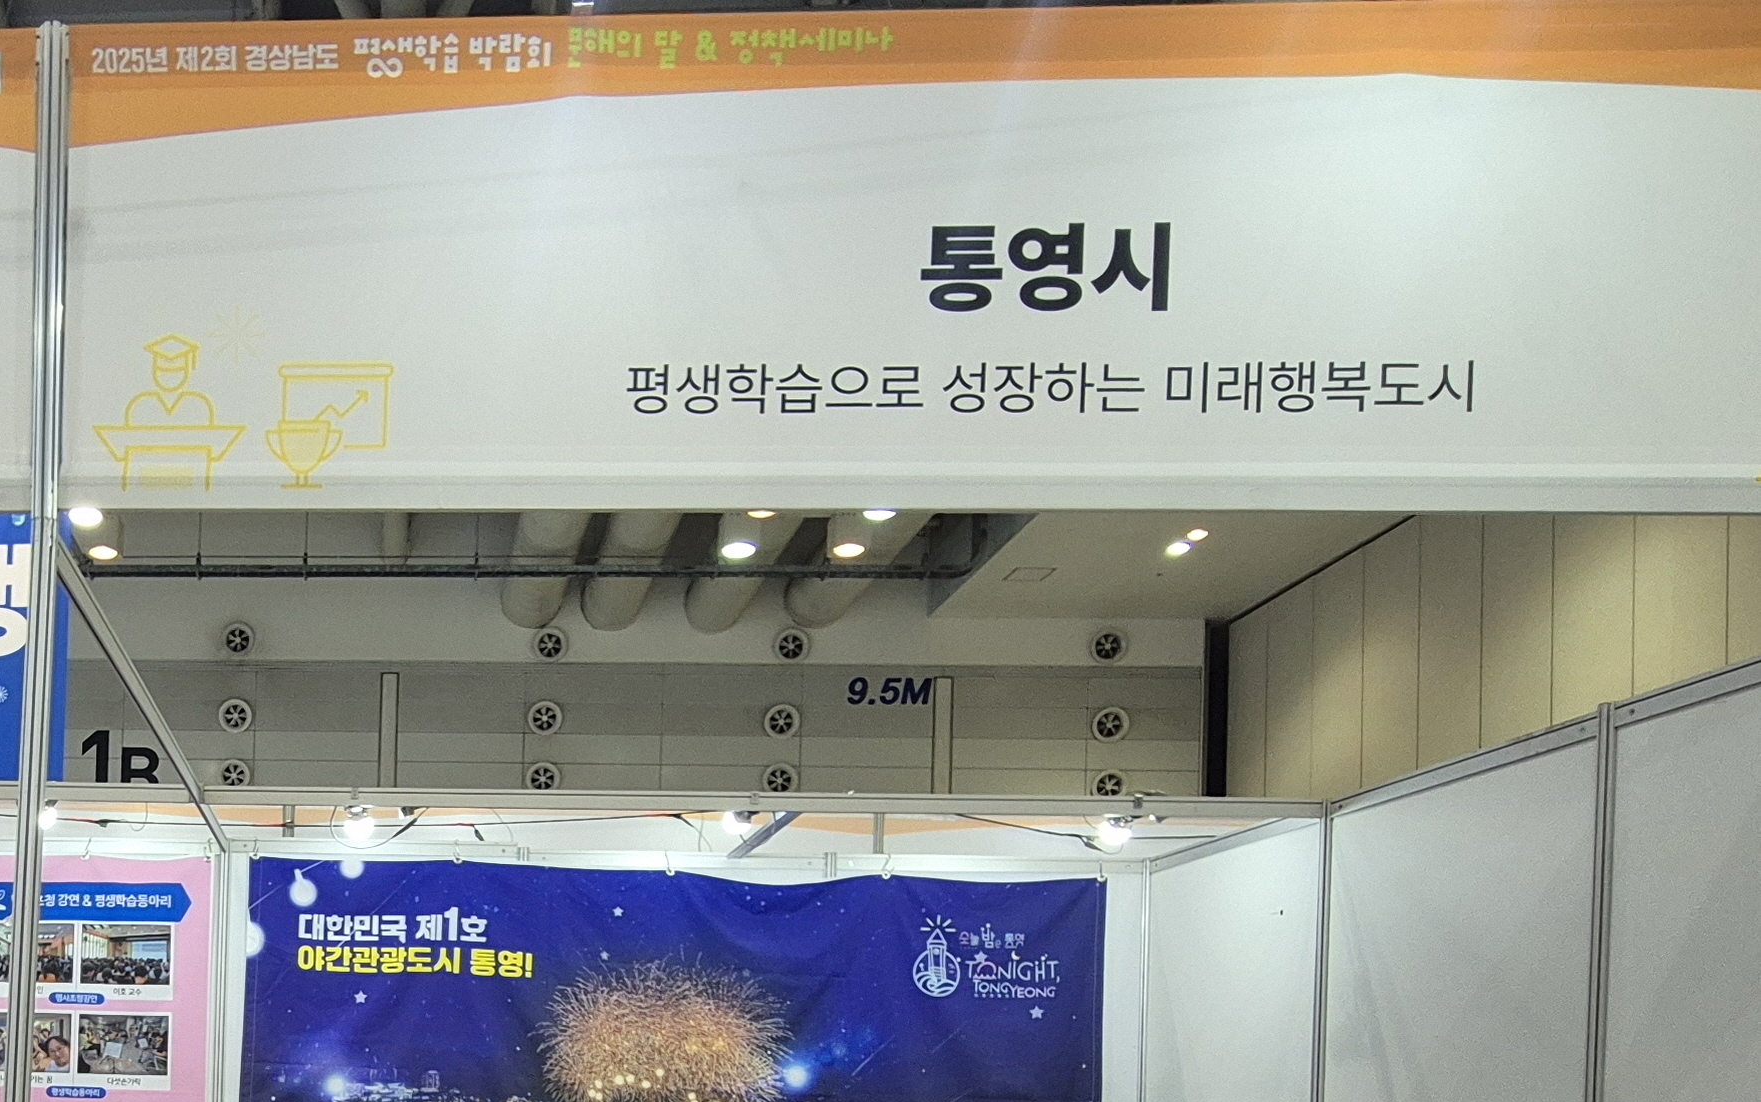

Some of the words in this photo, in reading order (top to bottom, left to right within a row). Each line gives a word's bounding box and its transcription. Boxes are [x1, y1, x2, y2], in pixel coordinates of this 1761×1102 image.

[91, 45, 169, 74] 2025년
[175, 44, 237, 73] 제2회
[244, 43, 339, 72] 경상남도
[353, 32, 460, 79] 평생학습
[468, 33, 553, 73] 박람회
[654, 28, 684, 69] 달
[695, 29, 718, 61] &
[920, 220, 1172, 312] 통영시
[625, 364, 926, 417] 평생학습으로
[940, 361, 1146, 416] 성장하는
[1162, 357, 1476, 414] 미래행복도시
[845, 676, 932, 707] 9.5M
[57, 893, 80, 908] 강연
[81, 894, 93, 907] &
[94, 894, 172, 909] 평생학습동아리
[297, 912, 408, 943] 대한민국
[414, 906, 488, 943] 제1호
[296, 944, 461, 975] 야간관광도시
[469, 948, 534, 979] 통영!
